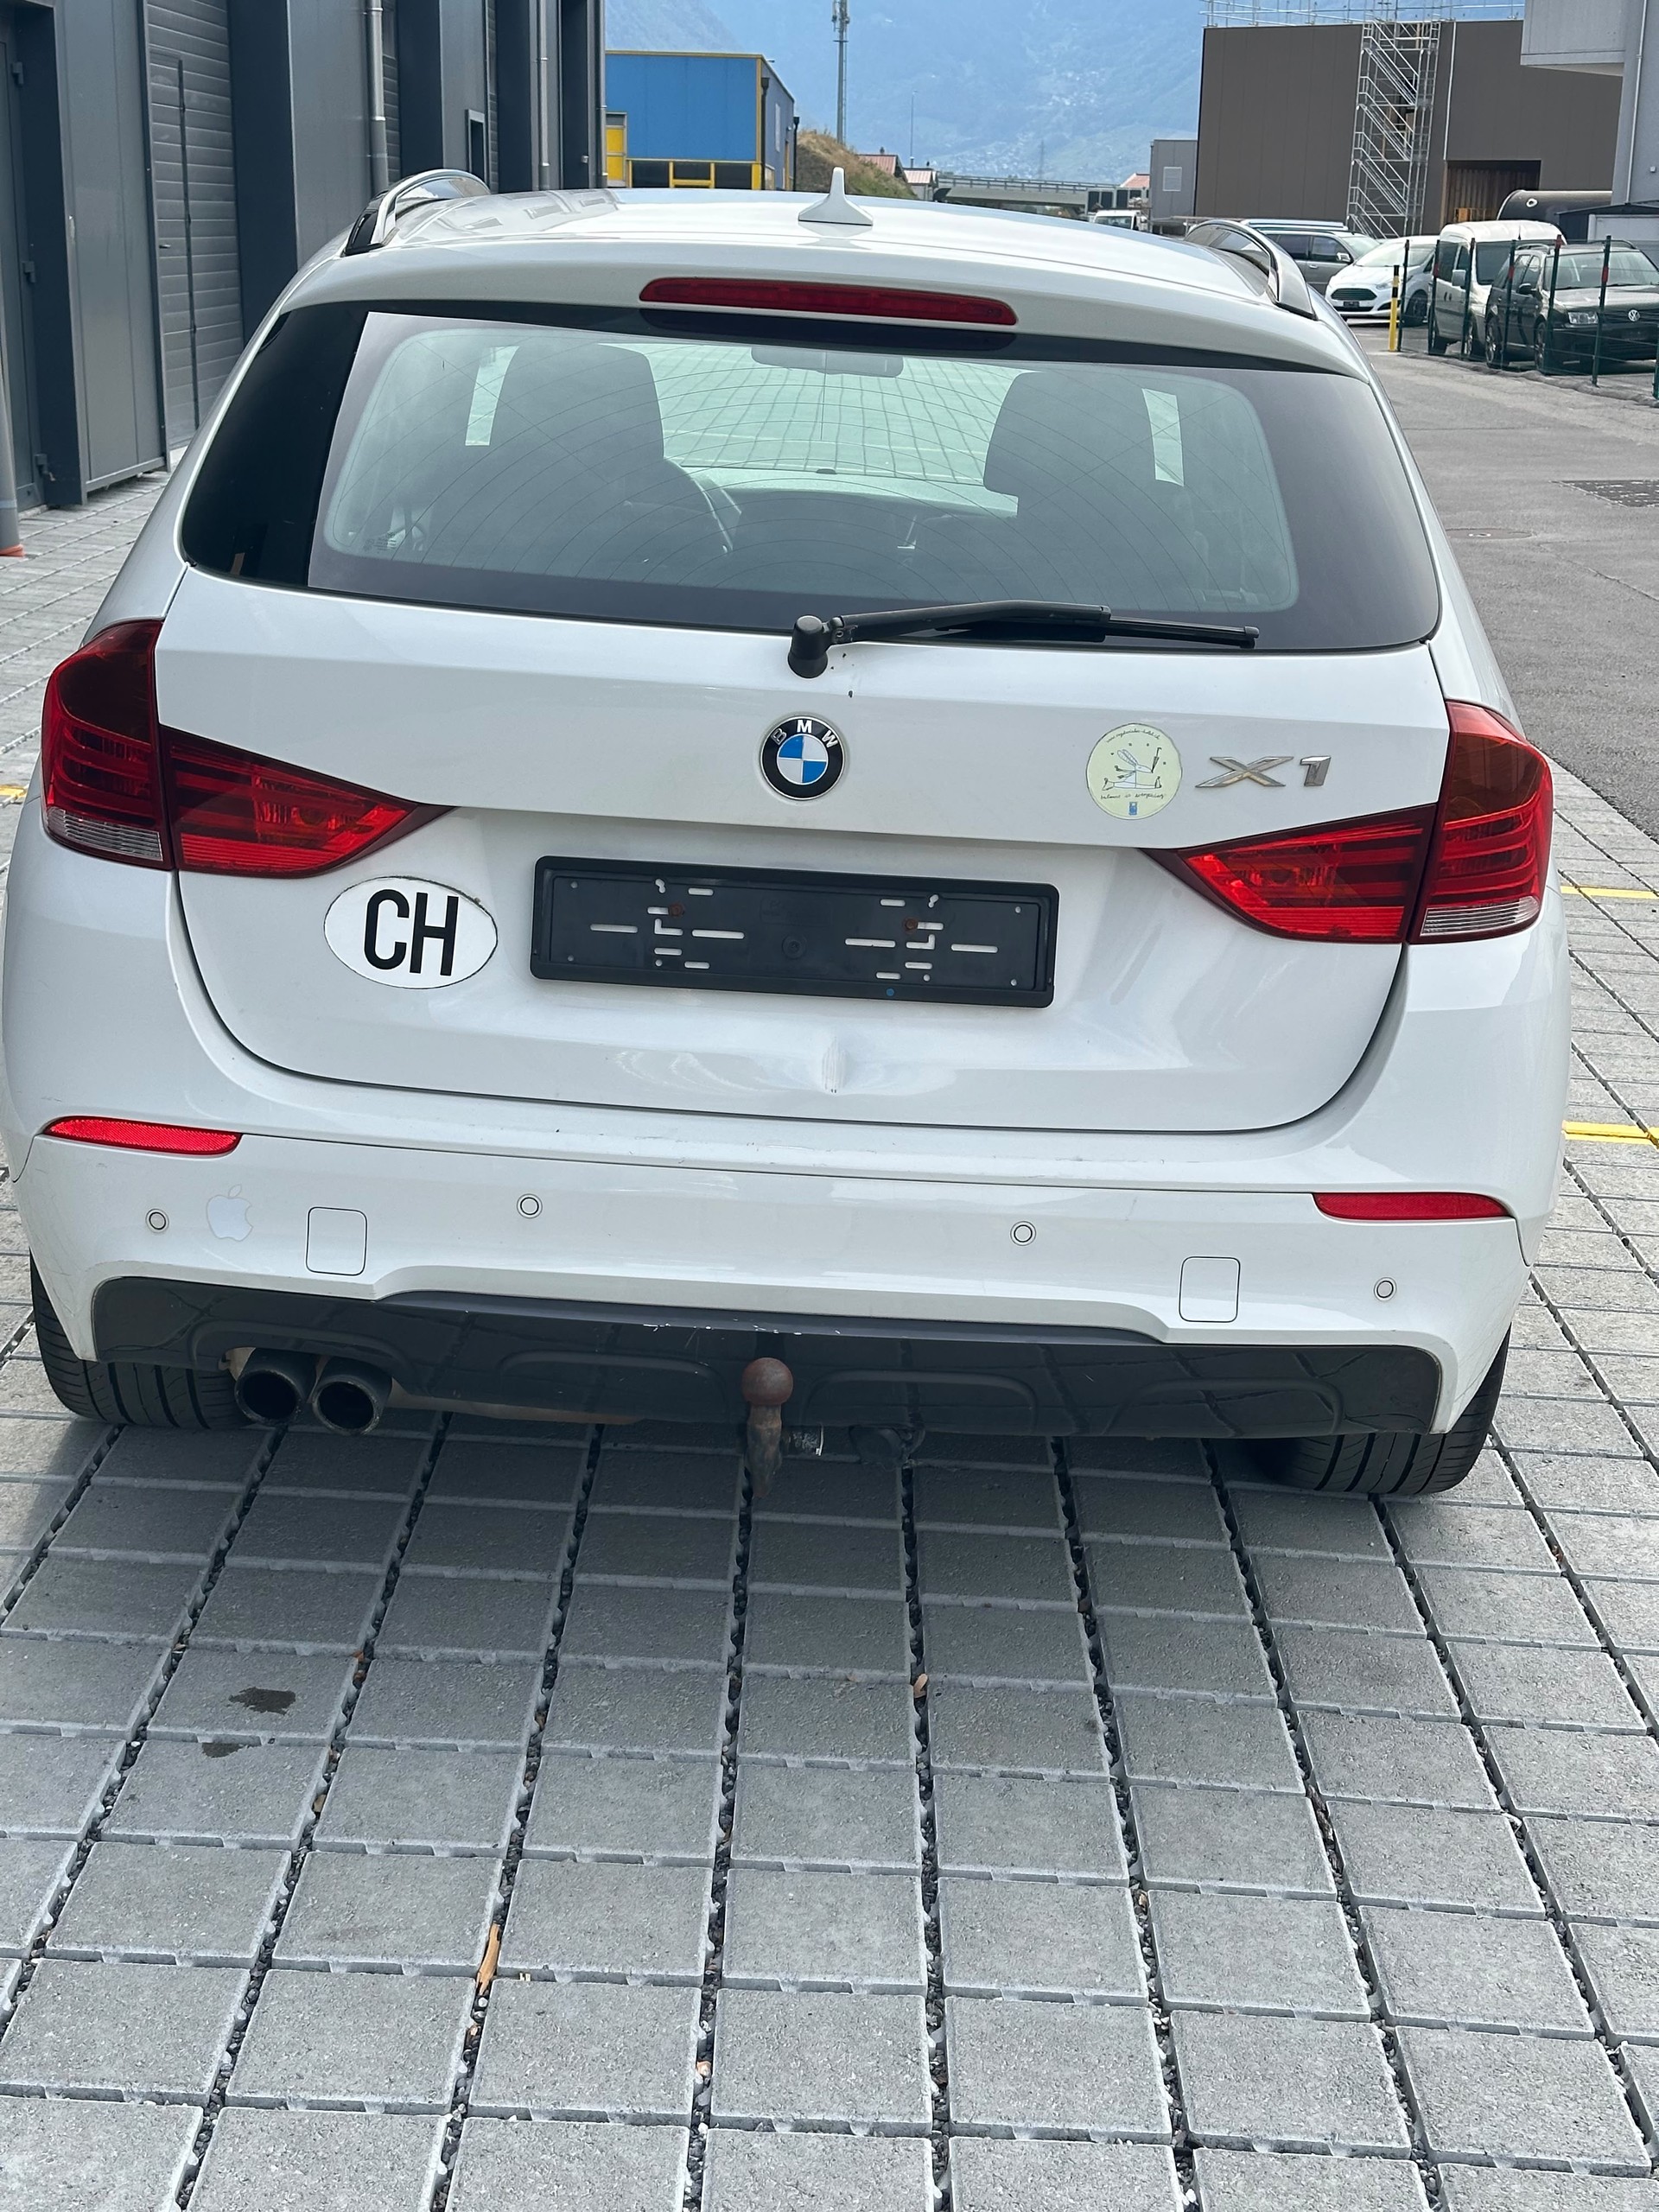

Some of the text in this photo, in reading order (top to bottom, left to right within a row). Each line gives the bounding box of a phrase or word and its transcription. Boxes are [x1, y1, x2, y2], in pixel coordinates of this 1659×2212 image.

[771, 719, 838, 748] BMW
[1194, 755, 1332, 789] X1
[364, 888, 460, 976] CH
